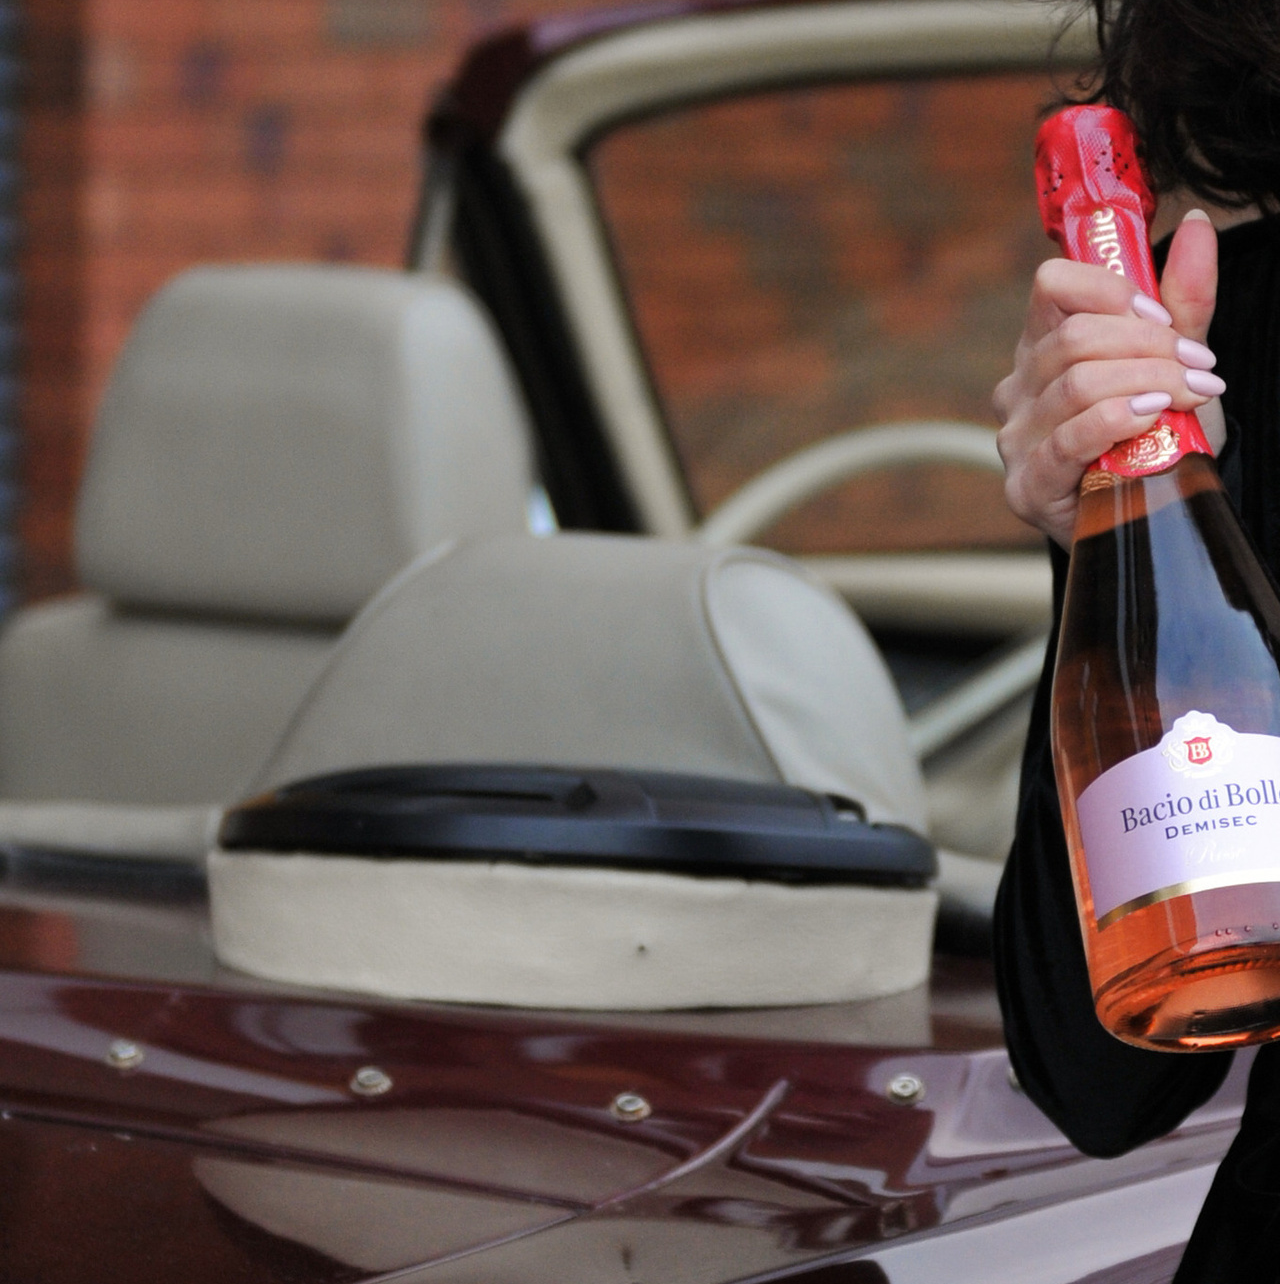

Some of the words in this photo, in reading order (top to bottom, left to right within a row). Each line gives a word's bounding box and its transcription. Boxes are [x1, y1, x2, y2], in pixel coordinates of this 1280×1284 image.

[1120, 793, 1194, 834] Bacio
[1198, 789, 1221, 811] di
[1164, 814, 1259, 840] DEMISEC
